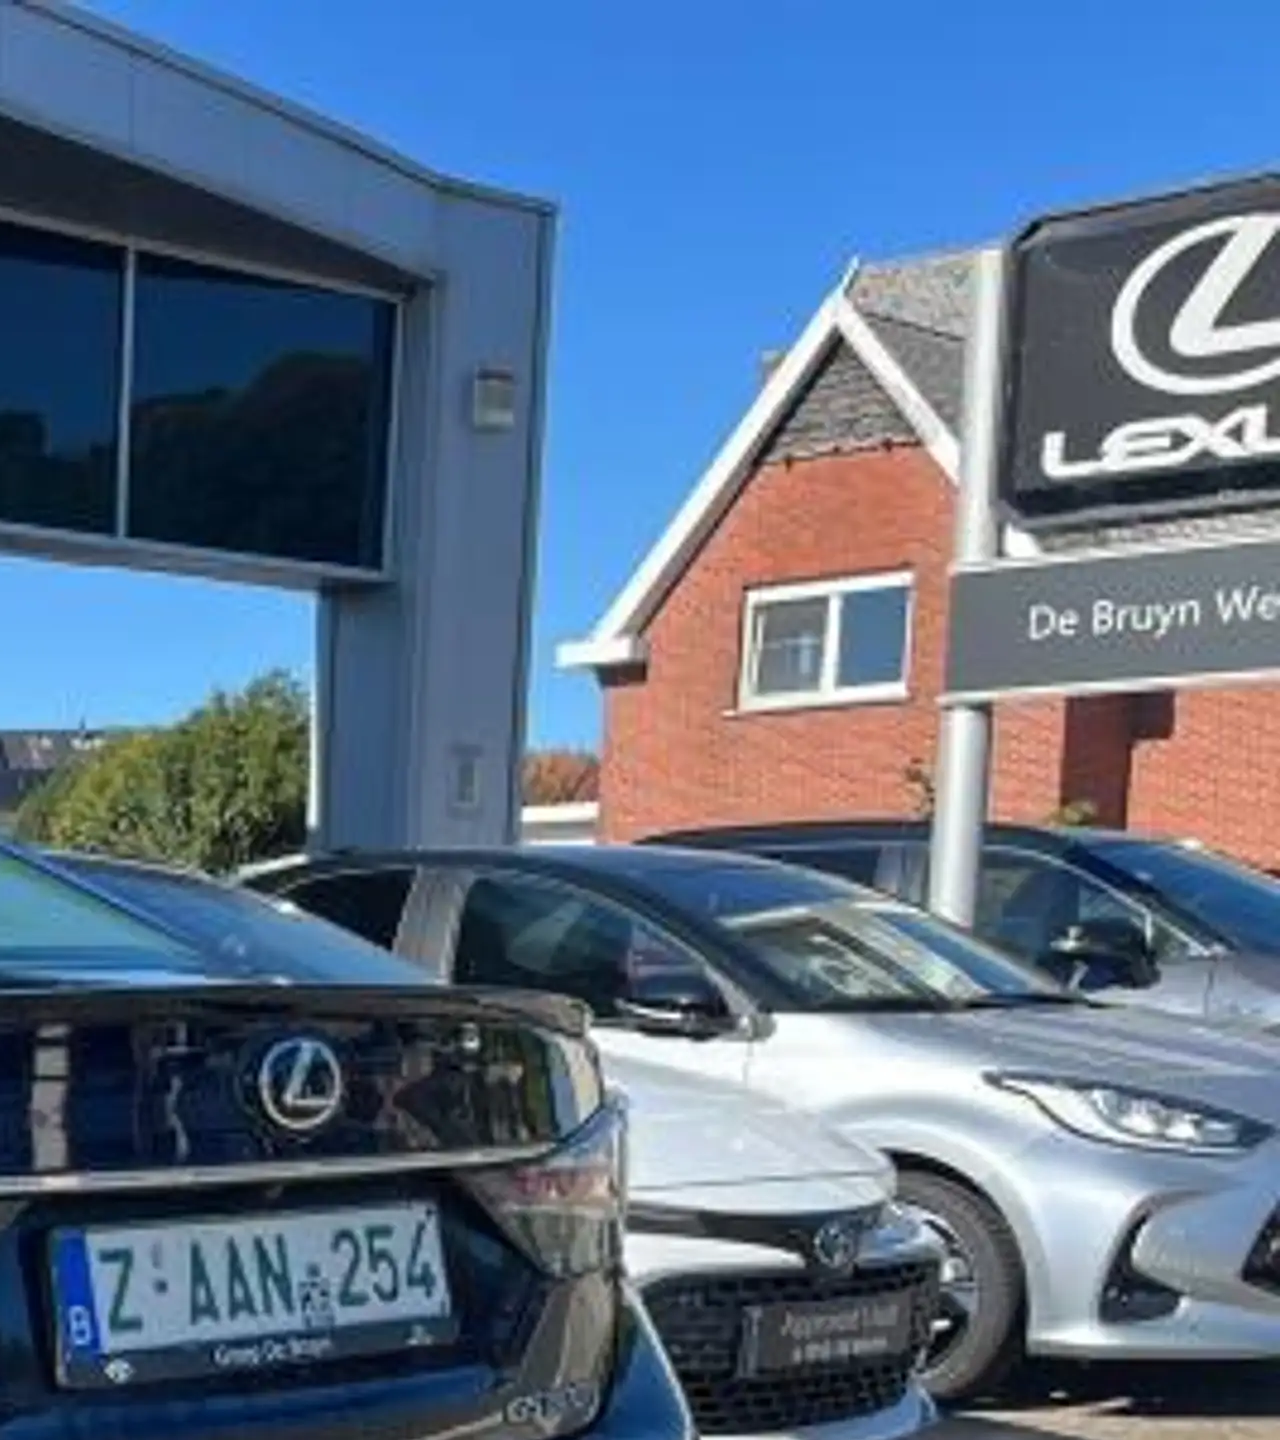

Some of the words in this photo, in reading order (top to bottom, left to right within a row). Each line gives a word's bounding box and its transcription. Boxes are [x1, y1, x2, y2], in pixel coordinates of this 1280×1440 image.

[1028, 603, 1079, 640] De
[1092, 595, 1201, 642] Bruyn
[68, 1306, 92, 1347] B
